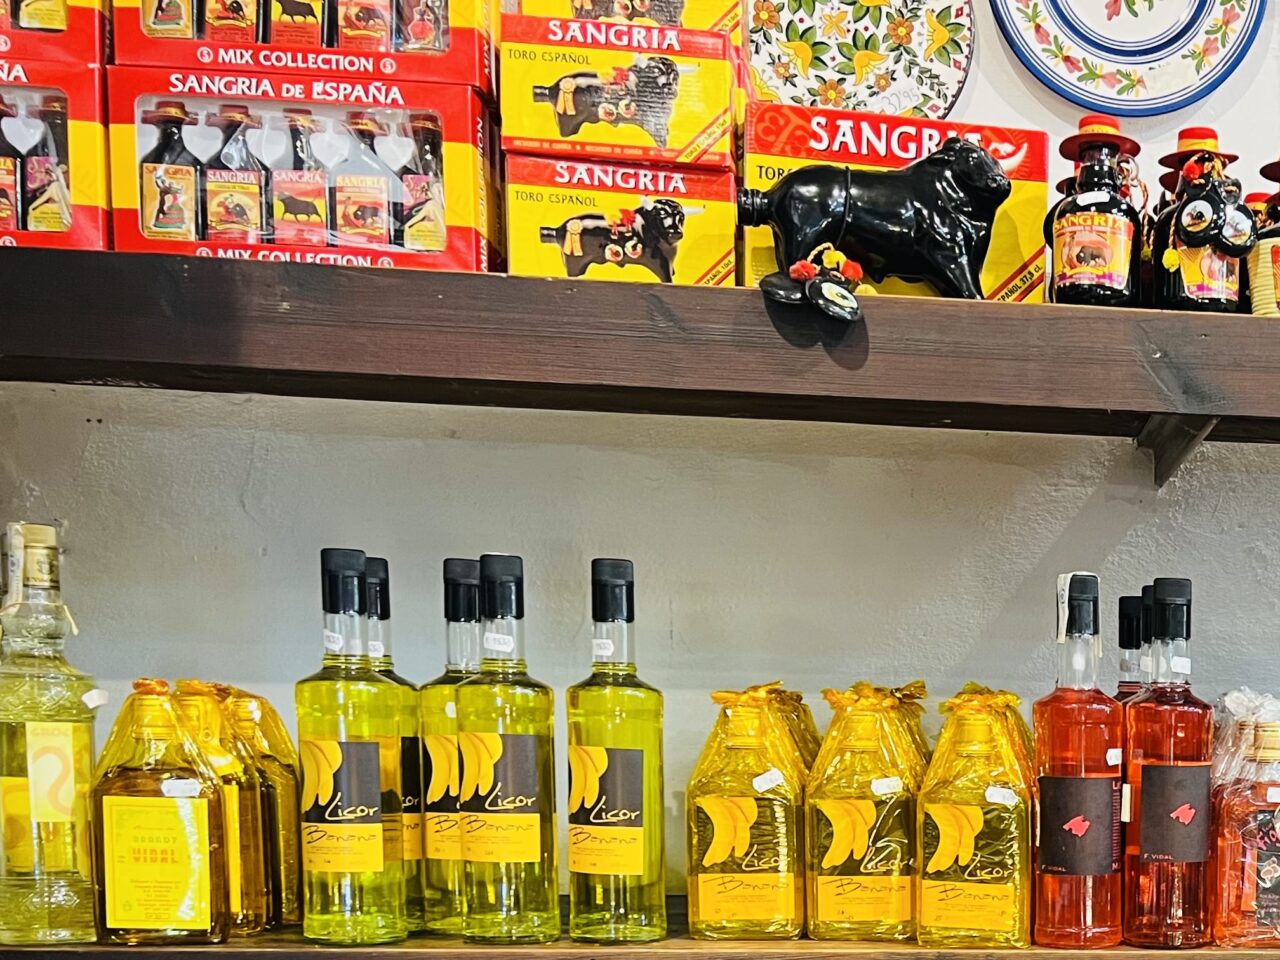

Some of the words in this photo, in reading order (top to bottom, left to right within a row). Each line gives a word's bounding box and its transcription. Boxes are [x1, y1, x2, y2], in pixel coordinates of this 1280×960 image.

[548, 20, 681, 51] SANGRIA
[218, 48, 254, 65] MIX
[259, 50, 374, 74] COLLECTION
[483, 40, 492, 79] MIX
[507, 48, 537, 62] TORO
[541, 50, 592, 66] ESPAÑOL
[169, 73, 273, 97] SANGRIA
[312, 79, 405, 105] ESPAÑA
[207, 170, 257, 184] SANGRIA
[272, 168, 324, 185] SANGRIA
[554, 162, 688, 194] SANGRIA
[515, 190, 544, 203] TORO
[549, 192, 598, 208] ESPAÑOL
[1054, 214, 1125, 231] SANGRIA
[325, 791, 379, 820] Licor
[485, 782, 537, 810] Licor
[590, 795, 640, 823] Licor
